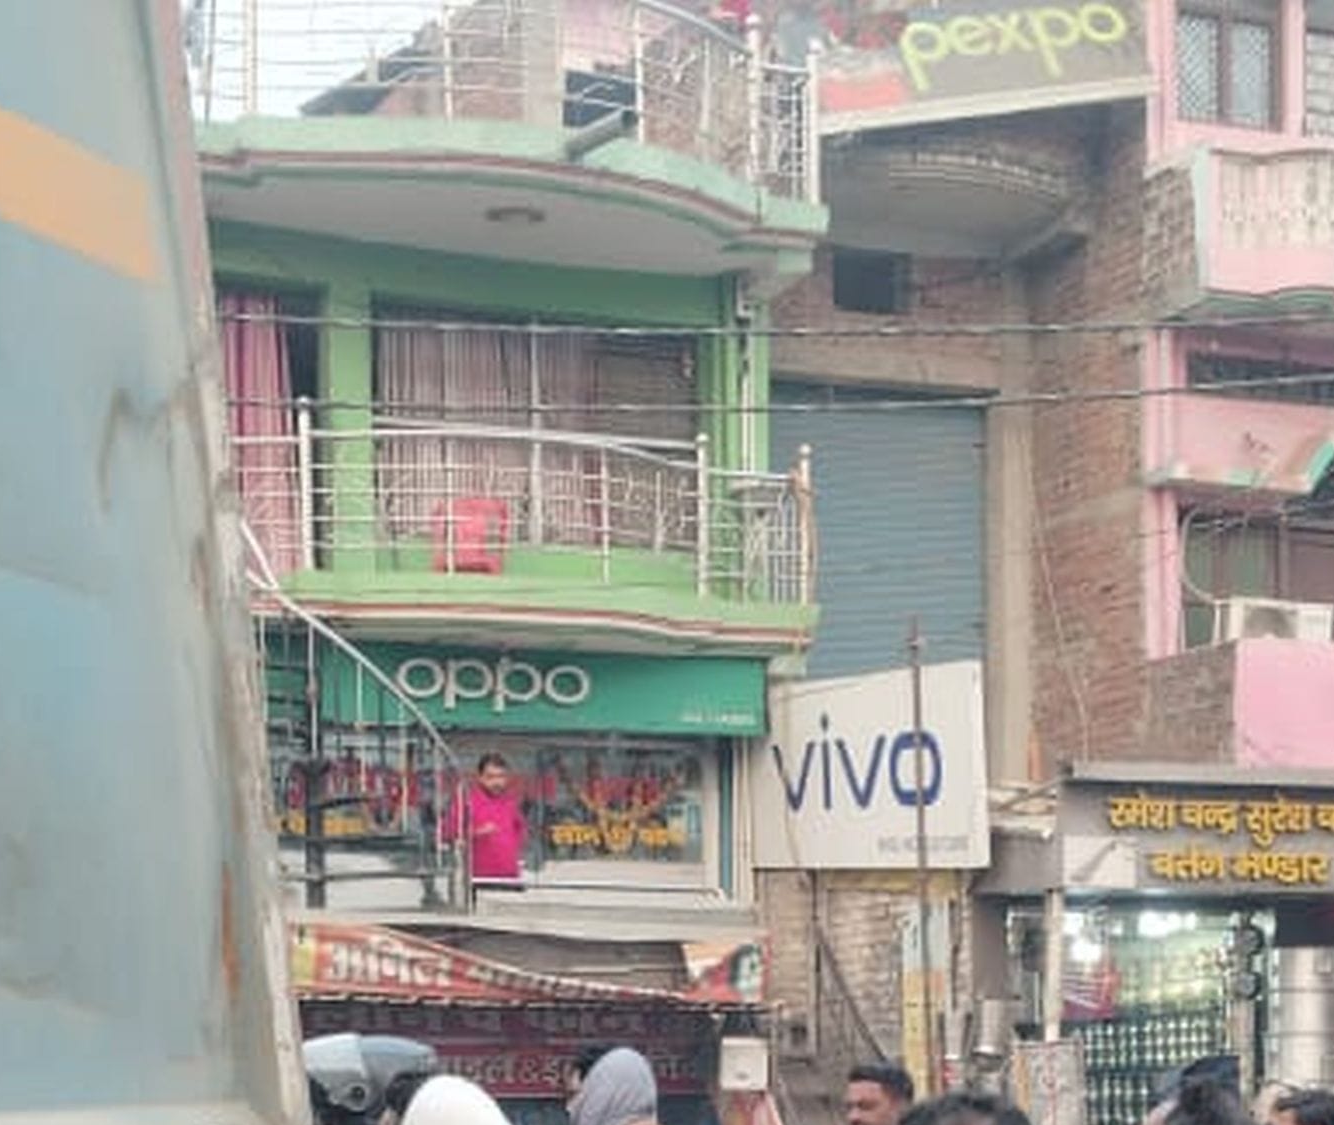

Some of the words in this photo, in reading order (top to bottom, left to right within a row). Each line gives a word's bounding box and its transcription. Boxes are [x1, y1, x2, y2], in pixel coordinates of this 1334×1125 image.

[900, 4, 1127, 92] pexpo
[397, 657, 591, 712] oppo
[773, 712, 942, 811] vivo
[1109, 789, 1175, 830] रमेश
[1181, 799, 1238, 835] चन्द्र
[1246, 791, 1311, 847] सुरेश
[1232, 852, 1329, 885] भण्डार
